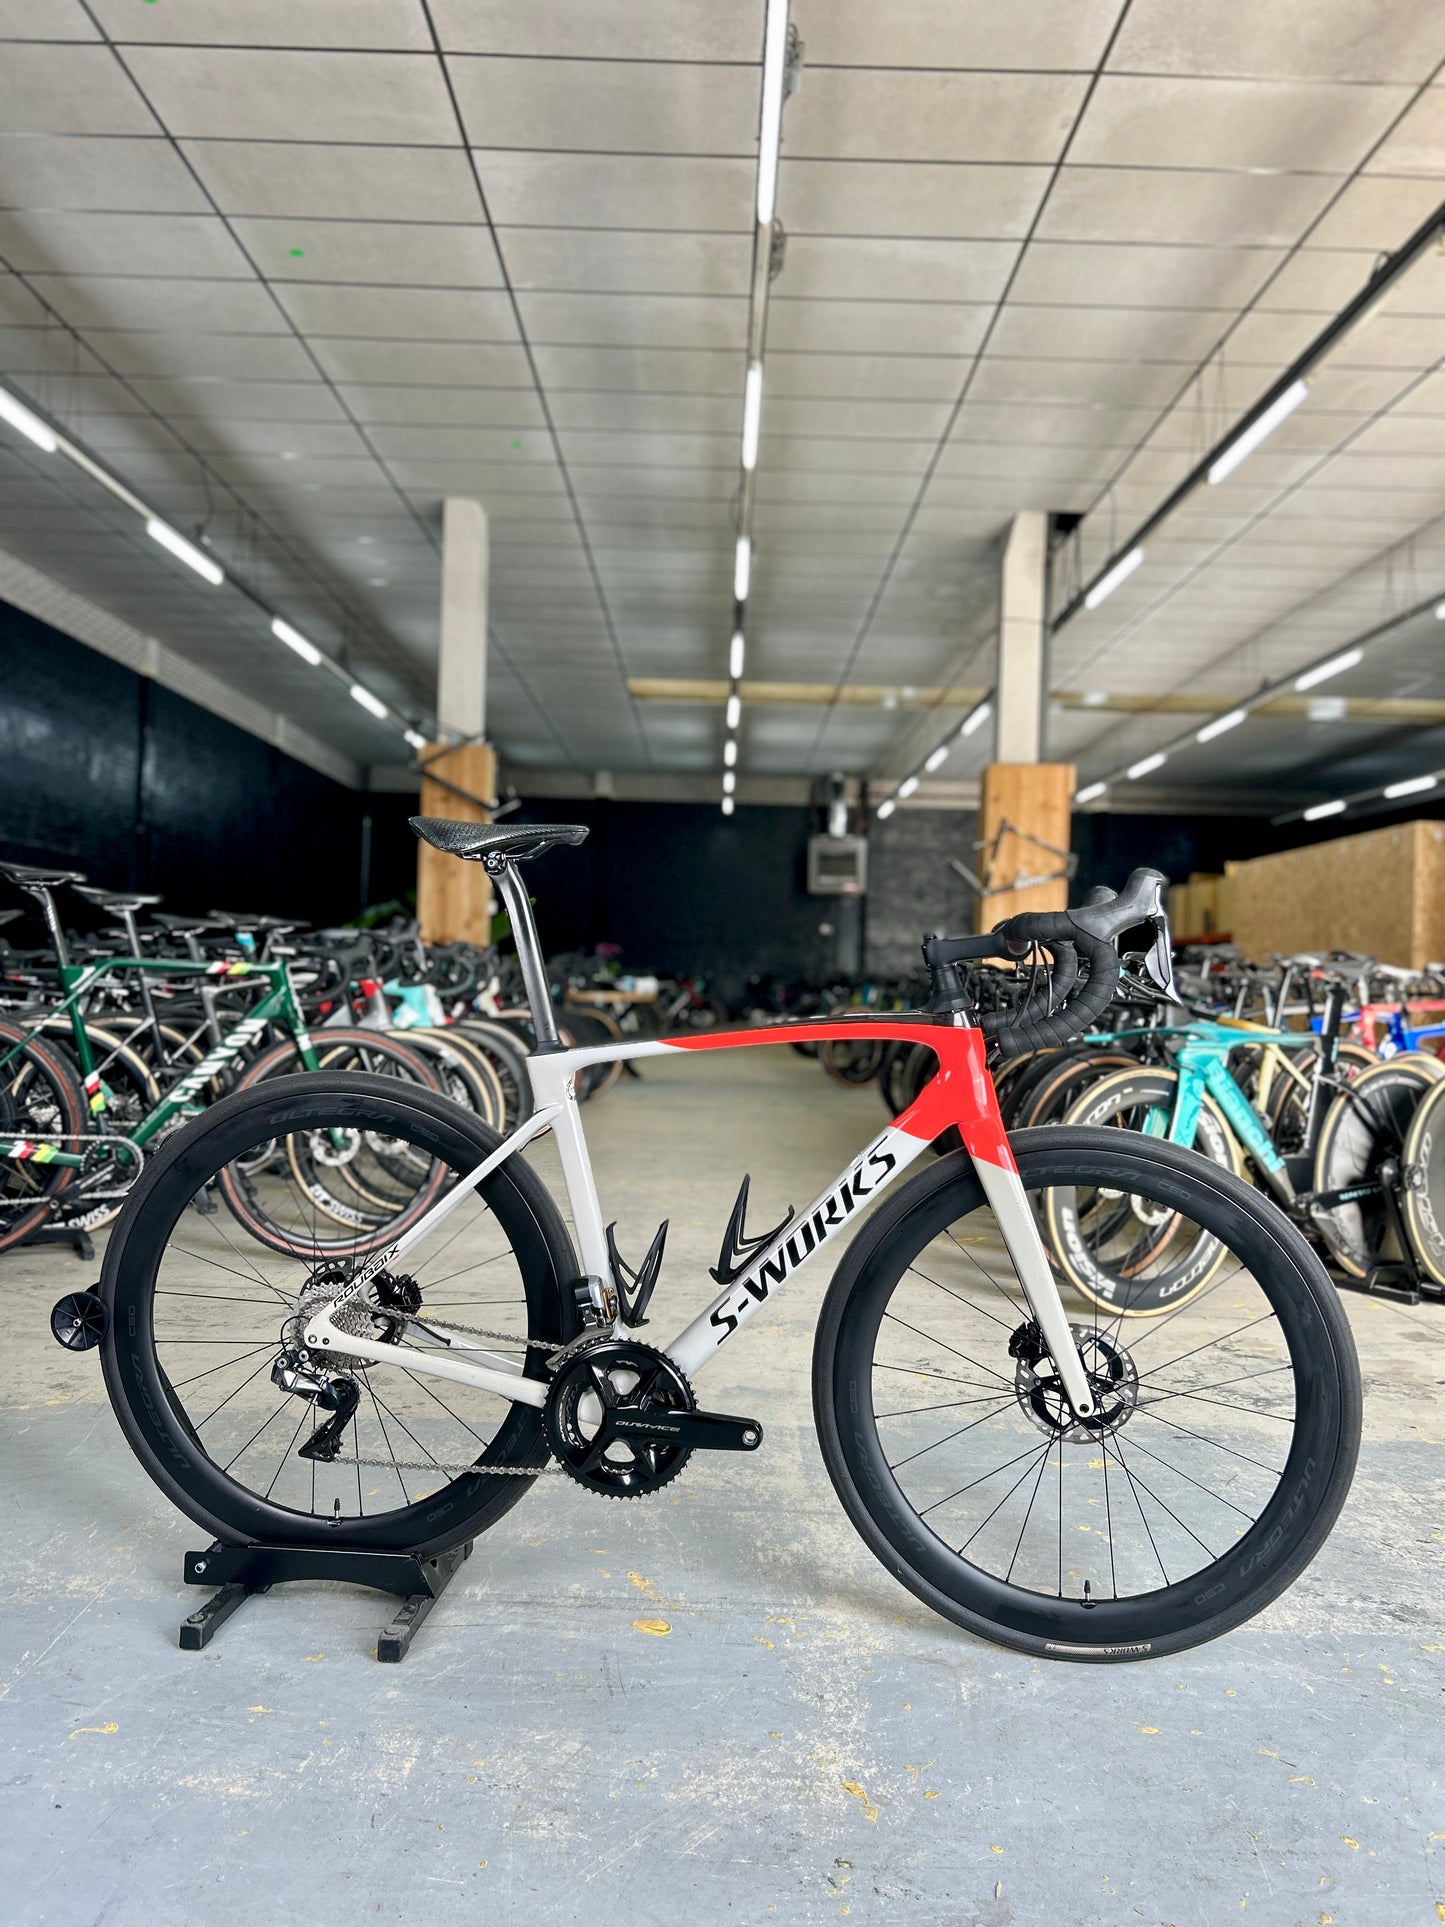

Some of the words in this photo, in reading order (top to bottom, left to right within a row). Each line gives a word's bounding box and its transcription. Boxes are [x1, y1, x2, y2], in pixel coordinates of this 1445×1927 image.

[168, 1018, 268, 1102] CANYON
[270, 1106, 396, 1125] ULTEGRA
[1206, 1058, 1286, 1174] Bianchi
[326, 1197, 363, 1224] SWISS
[1022, 1165, 1142, 1181] LTEGRA
[333, 1244, 400, 1309] ROUBAIX
[709, 1135, 896, 1346] S-WORKS
[131, 1352, 191, 1470] ULTEGRA
[1239, 1456, 1316, 1578] ULTEGRA
